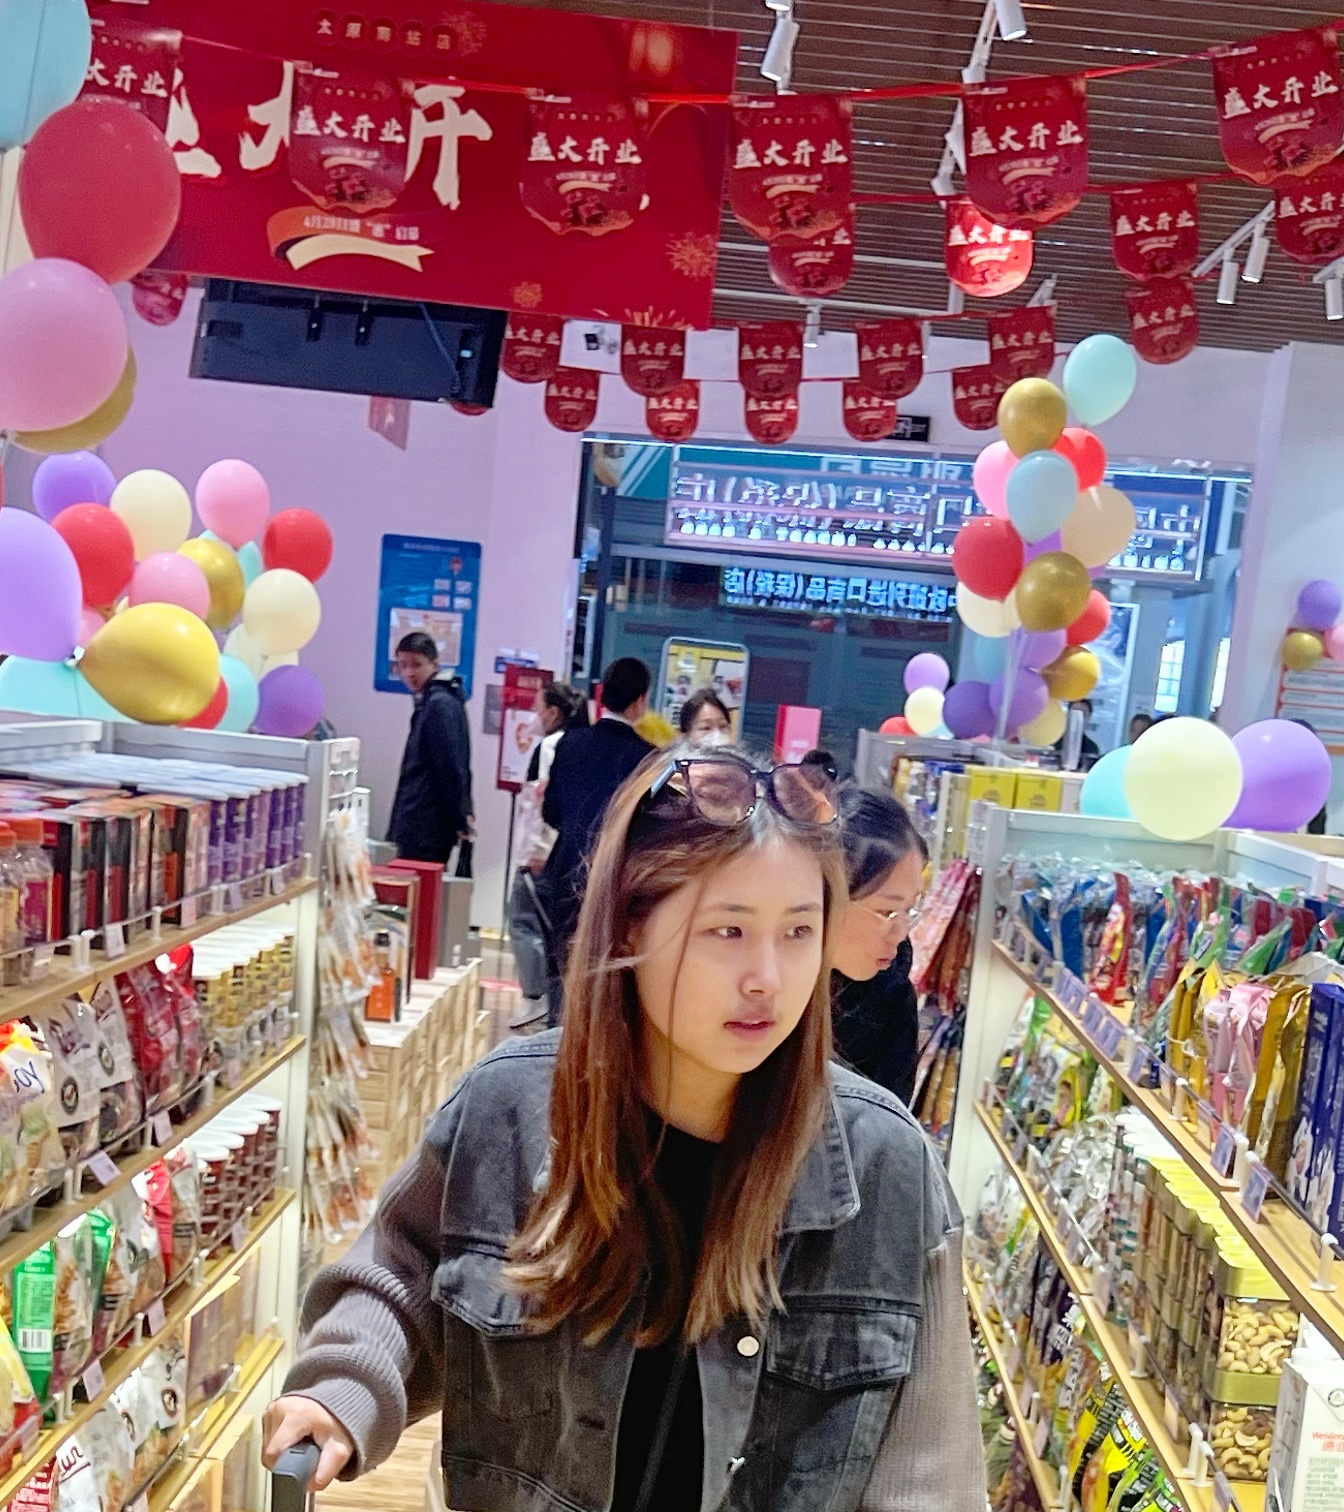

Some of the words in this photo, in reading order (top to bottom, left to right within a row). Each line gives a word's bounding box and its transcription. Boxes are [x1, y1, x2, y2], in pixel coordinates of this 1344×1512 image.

[85, 57, 169, 99] 大开业
[1222, 70, 1339, 119] 盛大开业
[293, 104, 406, 144] 盛大开业
[969, 119, 1084, 157] 盛大开业
[527, 131, 642, 165] 盛大开业
[732, 137, 849, 169] 盛大开业
[1114, 208, 1196, 237] 盛大开业
